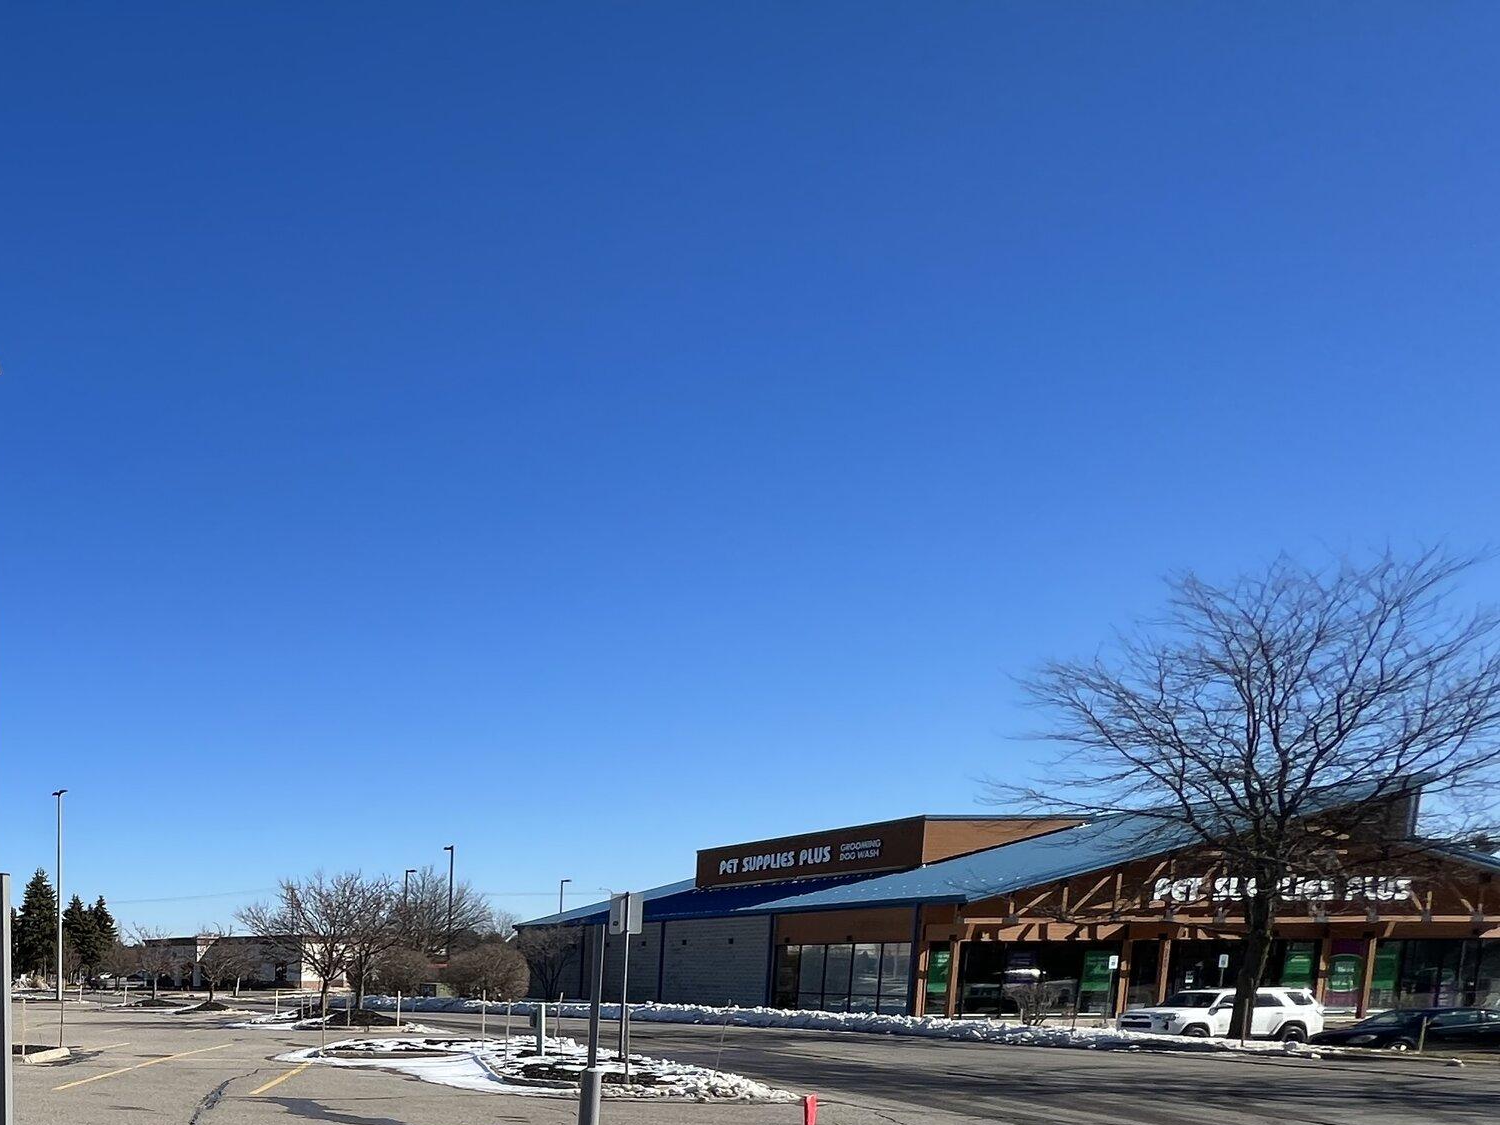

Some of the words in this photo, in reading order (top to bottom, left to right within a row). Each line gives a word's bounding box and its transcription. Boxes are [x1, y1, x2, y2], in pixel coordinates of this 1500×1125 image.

[840, 839, 881, 851] GROOMING
[719, 858, 739, 875] PET
[742, 851, 795, 872] SUPPLIES
[799, 846, 831, 865] PLUS
[857, 849, 879, 860] WASH
[1153, 877, 1205, 900] PET
[1344, 877, 1412, 900] PLUS
